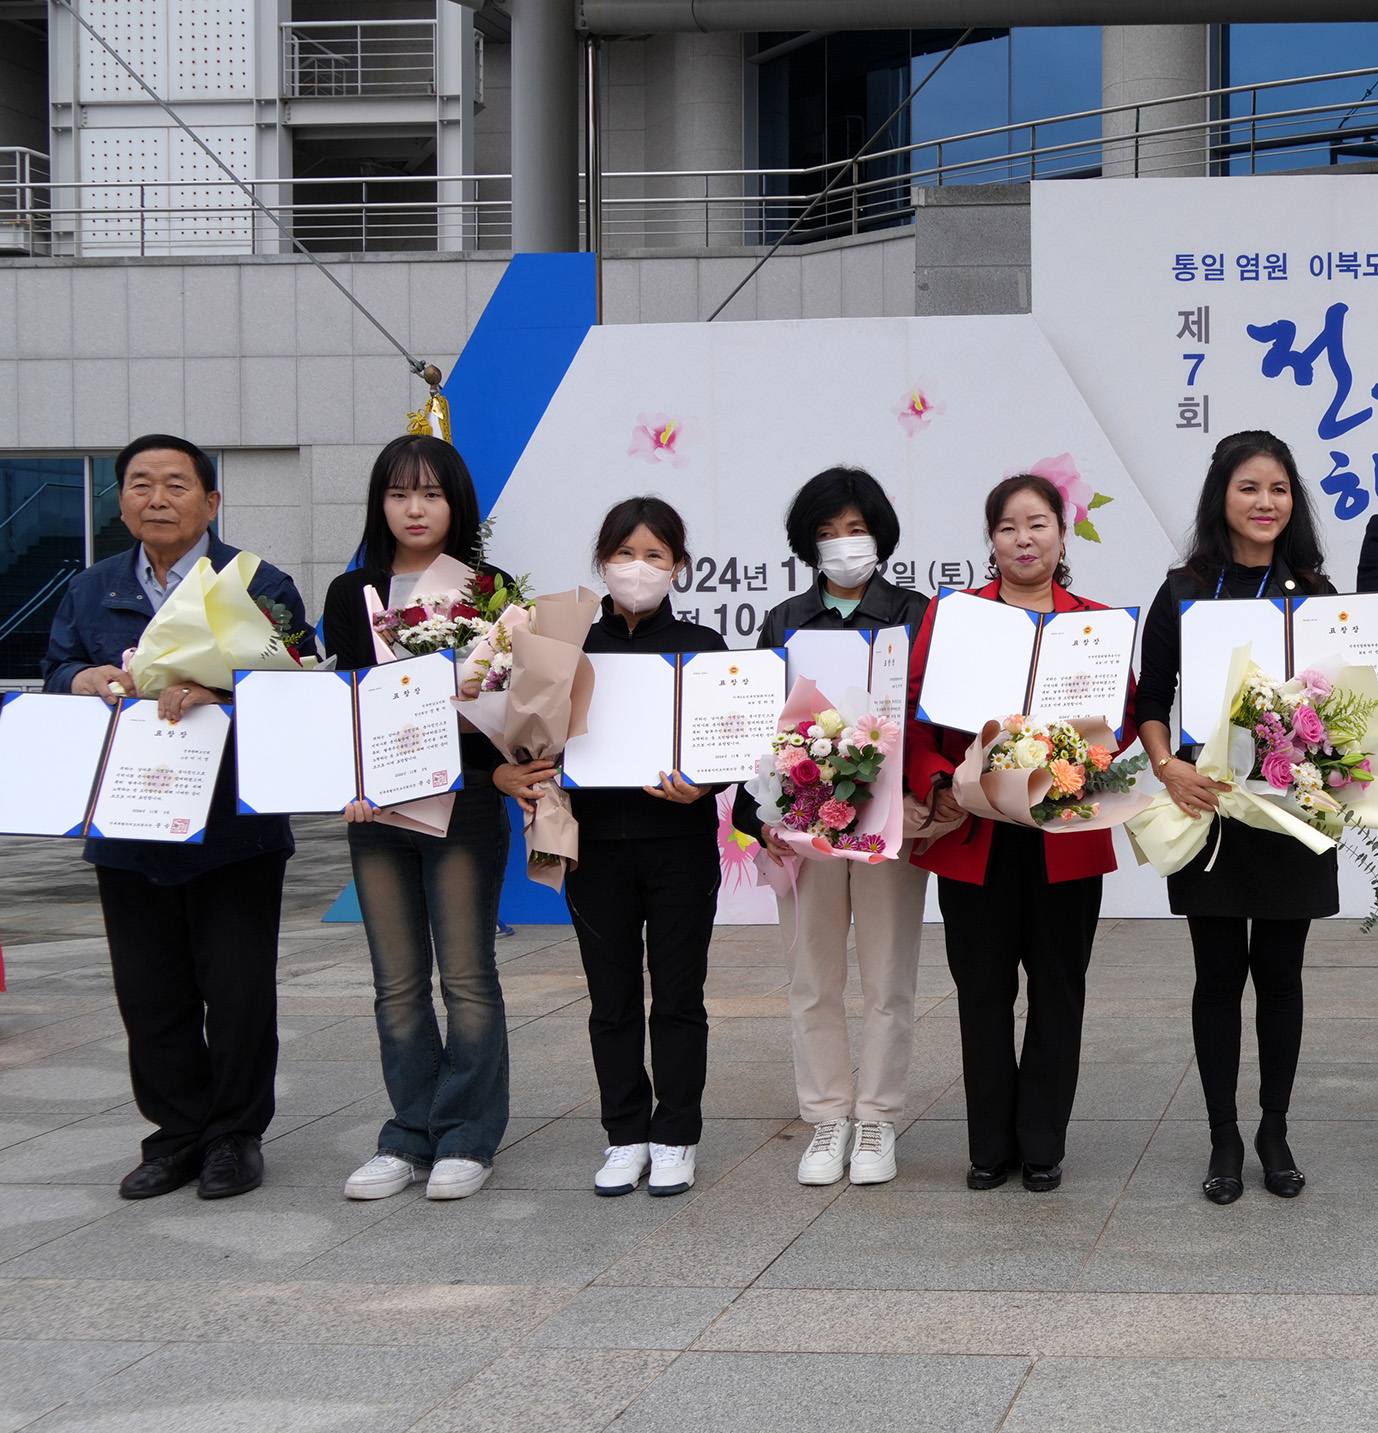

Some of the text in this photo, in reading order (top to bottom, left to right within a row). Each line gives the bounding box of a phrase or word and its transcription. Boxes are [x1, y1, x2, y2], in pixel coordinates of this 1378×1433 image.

[1172, 253, 1225, 281] 통일
[1235, 252, 1288, 280] 염원
[929, 560, 974, 589] (토)
